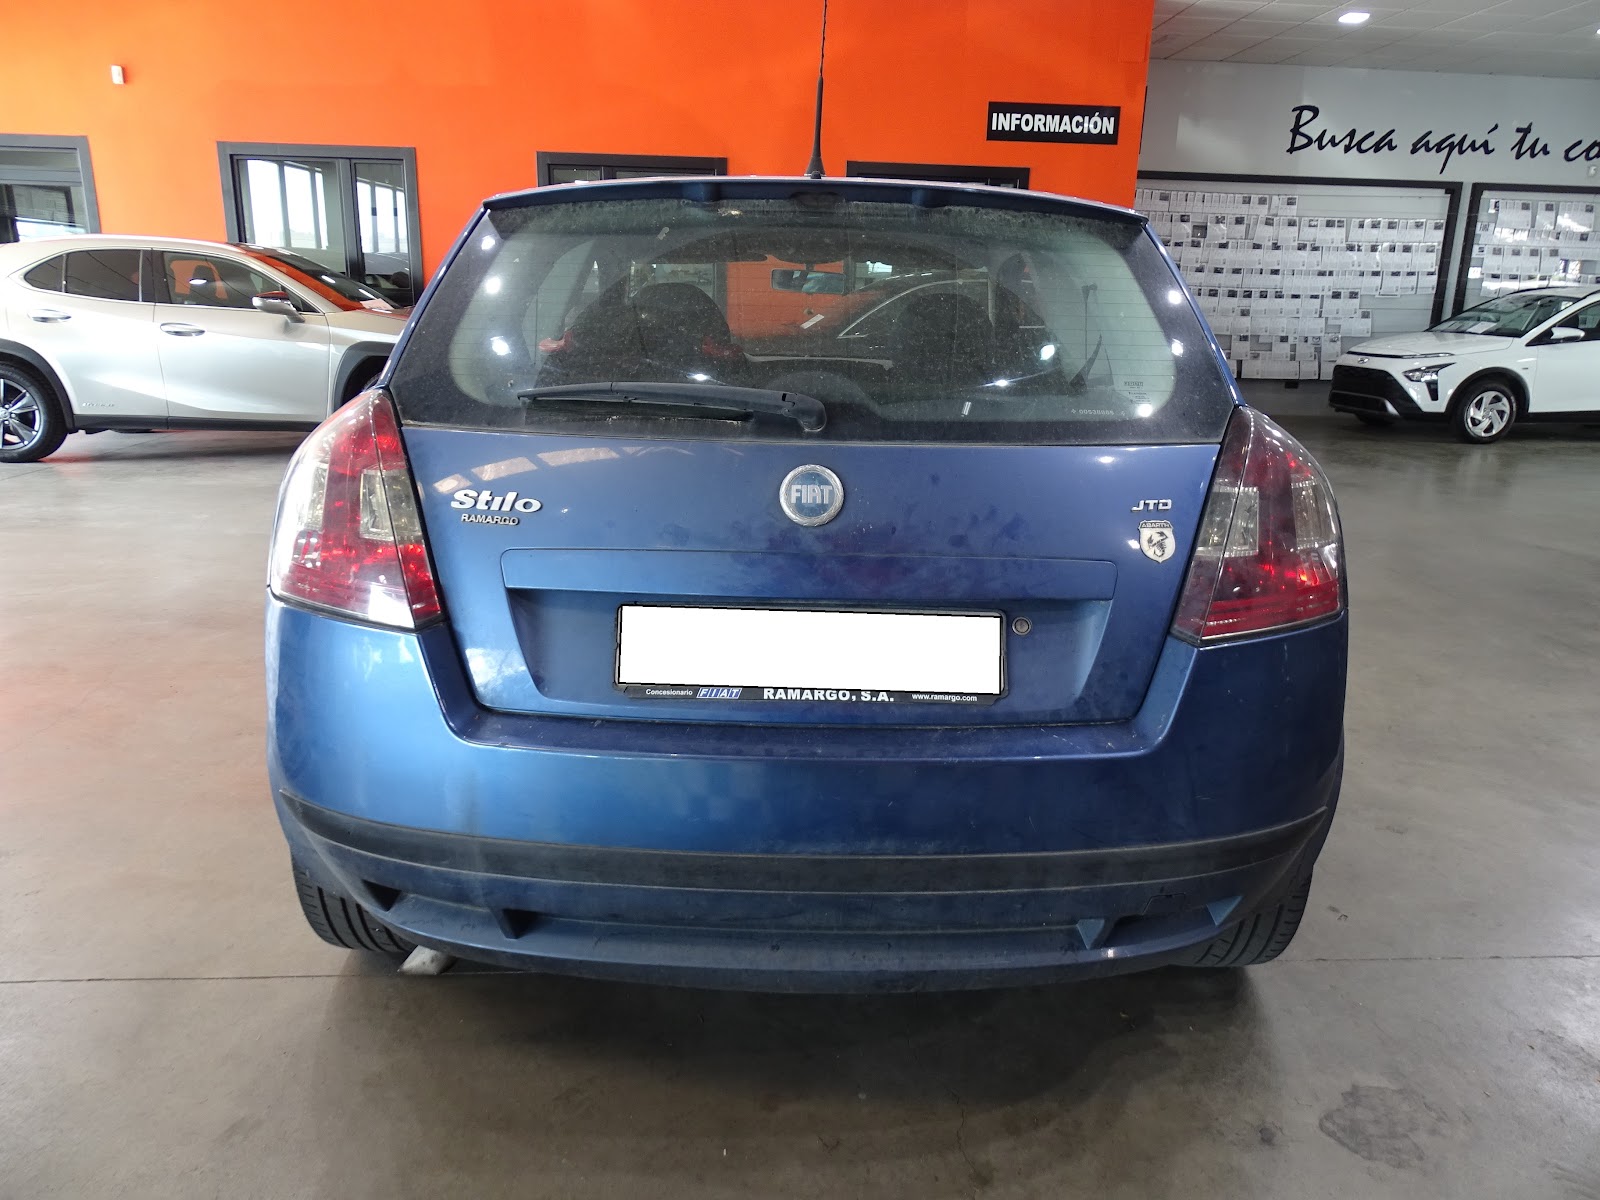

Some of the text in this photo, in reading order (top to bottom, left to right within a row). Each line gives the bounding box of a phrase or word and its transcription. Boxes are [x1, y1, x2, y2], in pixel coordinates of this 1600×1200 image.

[991, 112, 1115, 135] INFORMACIÓN
[1286, 105, 1397, 154] Busca
[1410, 123, 1499, 174] aquí
[1511, 122, 1550, 160] tu
[450, 489, 543, 513] Stilo
[791, 484, 832, 504] FIAT
[1131, 499, 1172, 511] JTD
[461, 513, 520, 526] RAMARGO
[645, 687, 978, 702] Concesionario FIAT RAMARGO, S.A. www.ramargo.com
